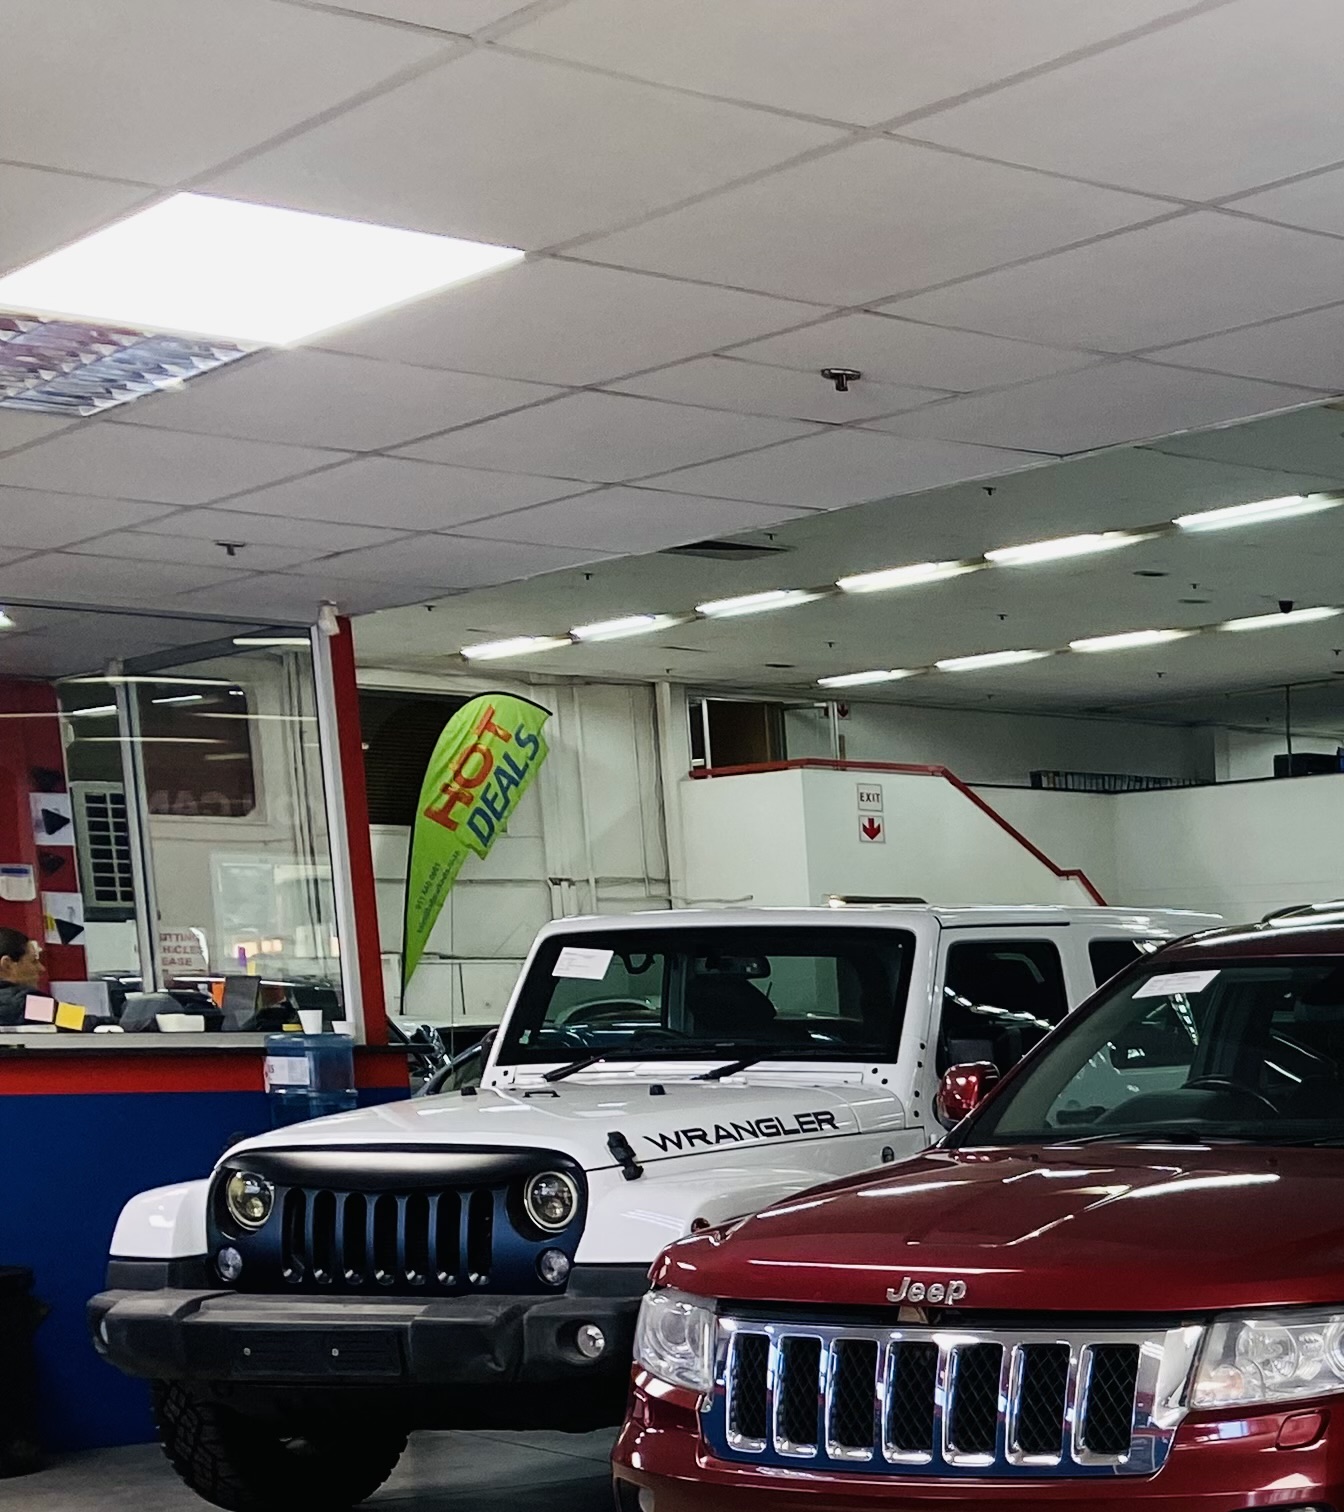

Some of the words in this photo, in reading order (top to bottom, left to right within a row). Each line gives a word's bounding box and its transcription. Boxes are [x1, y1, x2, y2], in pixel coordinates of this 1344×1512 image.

[424, 704, 512, 832] HOT
[467, 723, 540, 847] DEALS
[859, 791, 881, 803] EXIT
[643, 1110, 840, 1152] WRANGLER
[886, 1277, 967, 1305] Jeep
